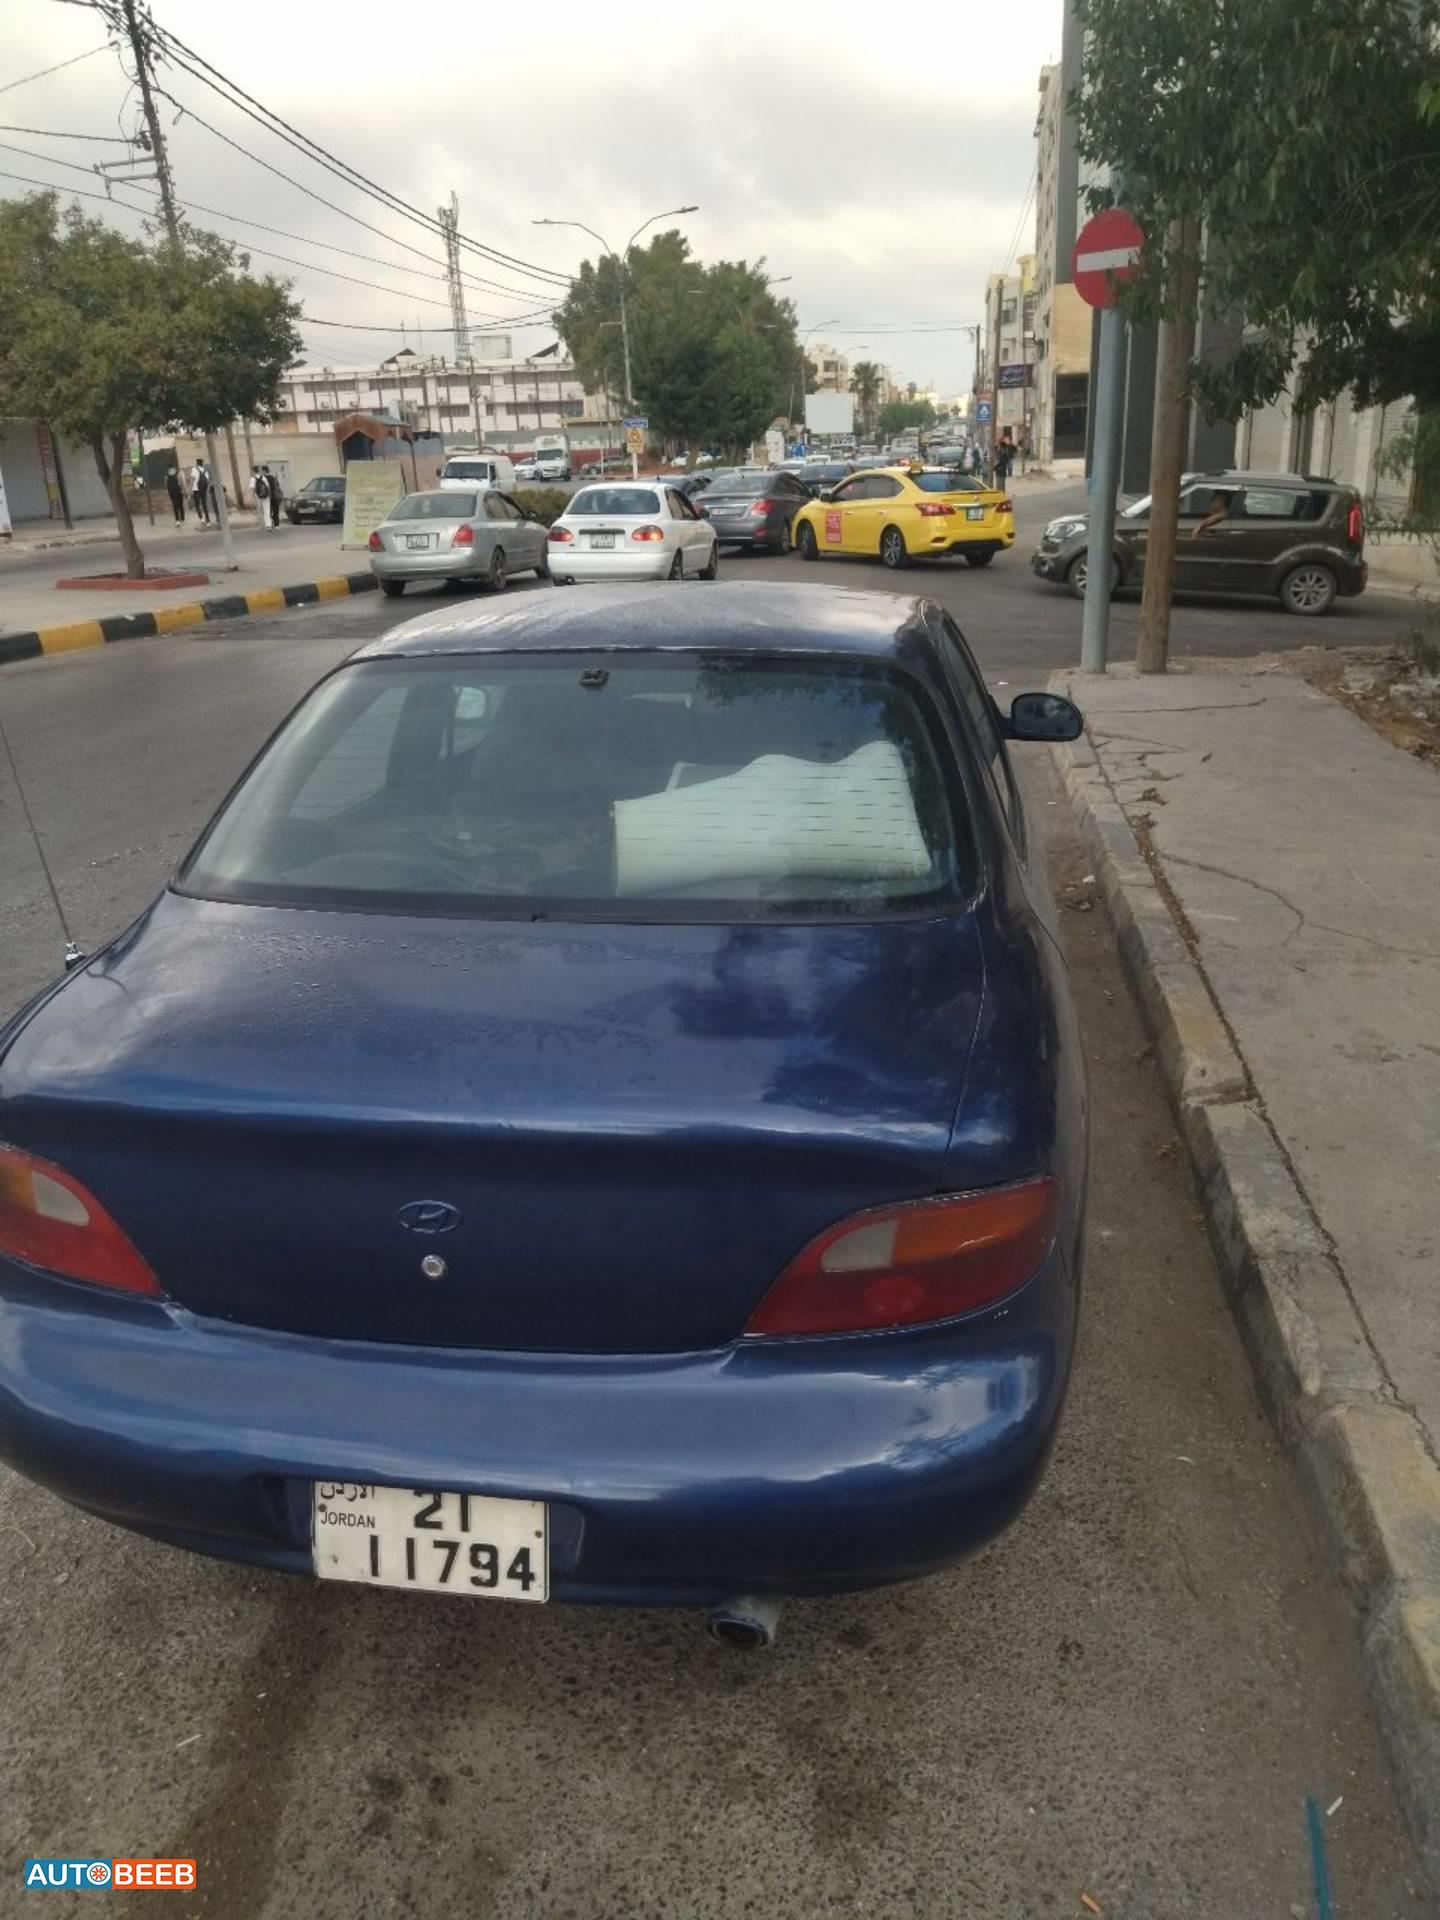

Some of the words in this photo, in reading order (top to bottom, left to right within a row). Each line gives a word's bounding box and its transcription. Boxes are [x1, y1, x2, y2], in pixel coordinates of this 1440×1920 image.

[320, 1511, 375, 1529] JORDAN
[413, 1490, 470, 1532] 21
[370, 1535, 535, 1591] 11794
